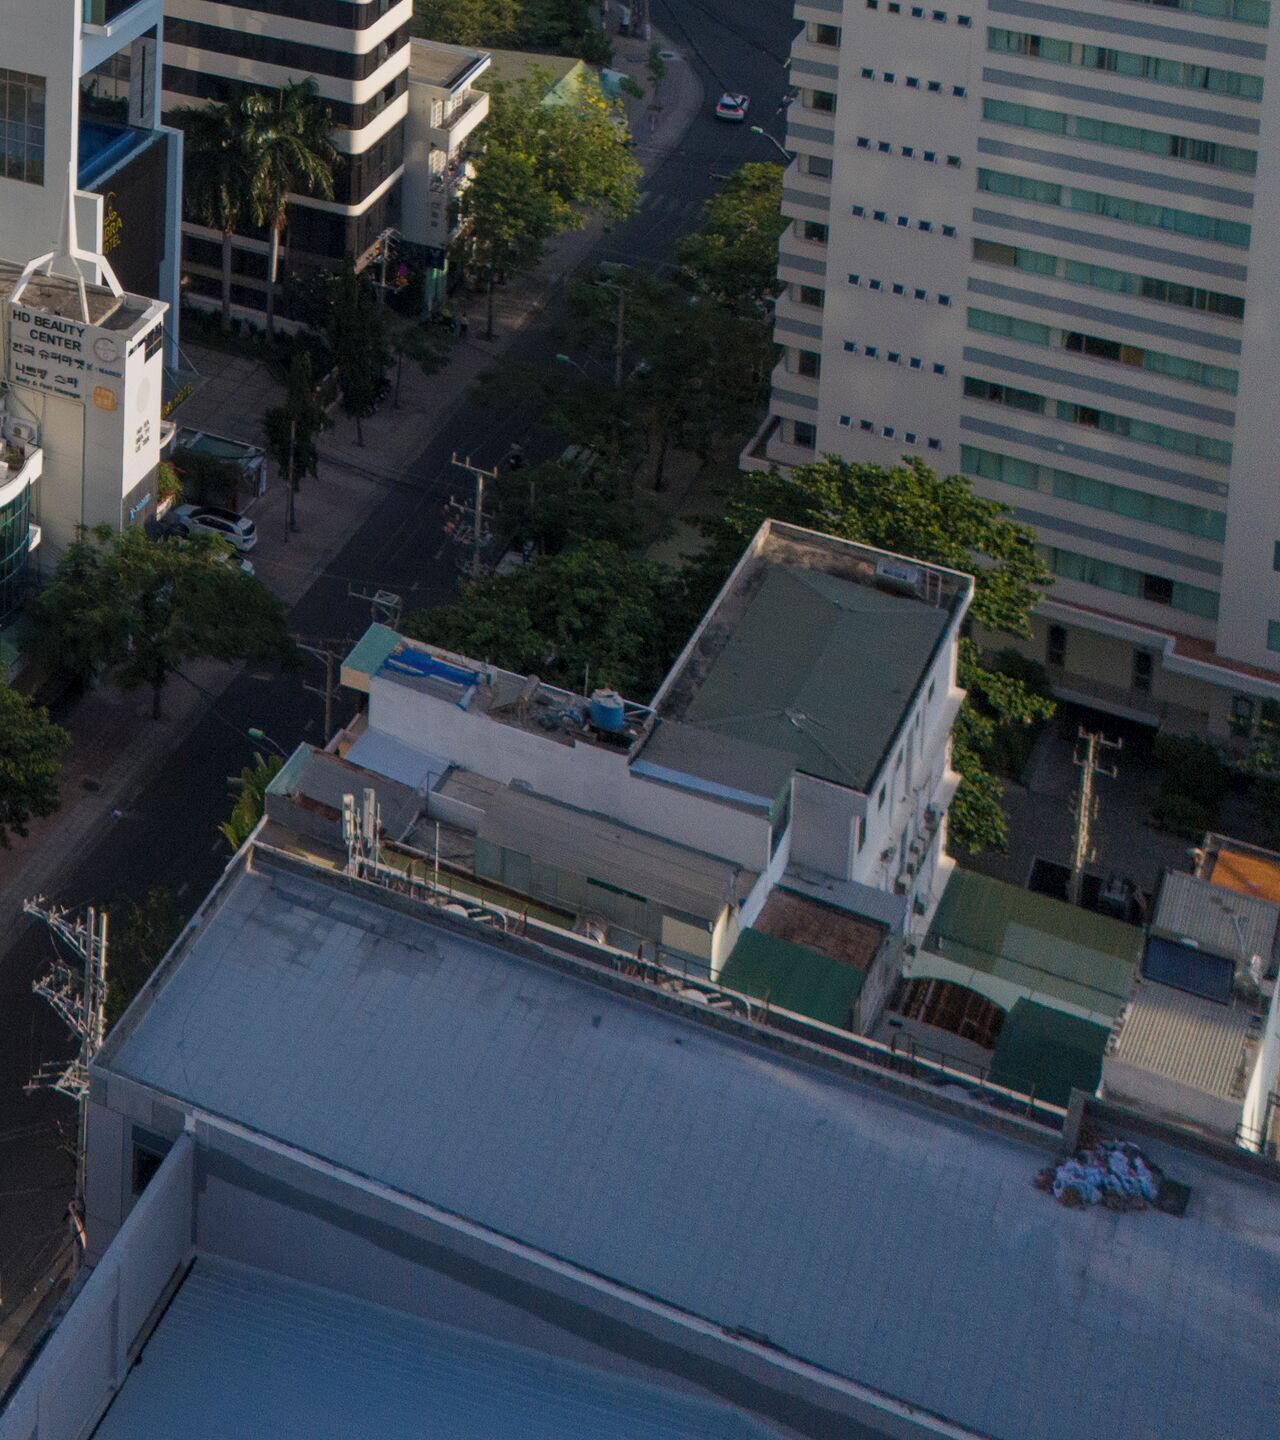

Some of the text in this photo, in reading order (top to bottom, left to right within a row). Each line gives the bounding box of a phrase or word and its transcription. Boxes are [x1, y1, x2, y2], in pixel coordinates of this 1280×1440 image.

[13, 310, 85, 338] HD BEAUTY
[30, 329, 82, 352] CENTER
